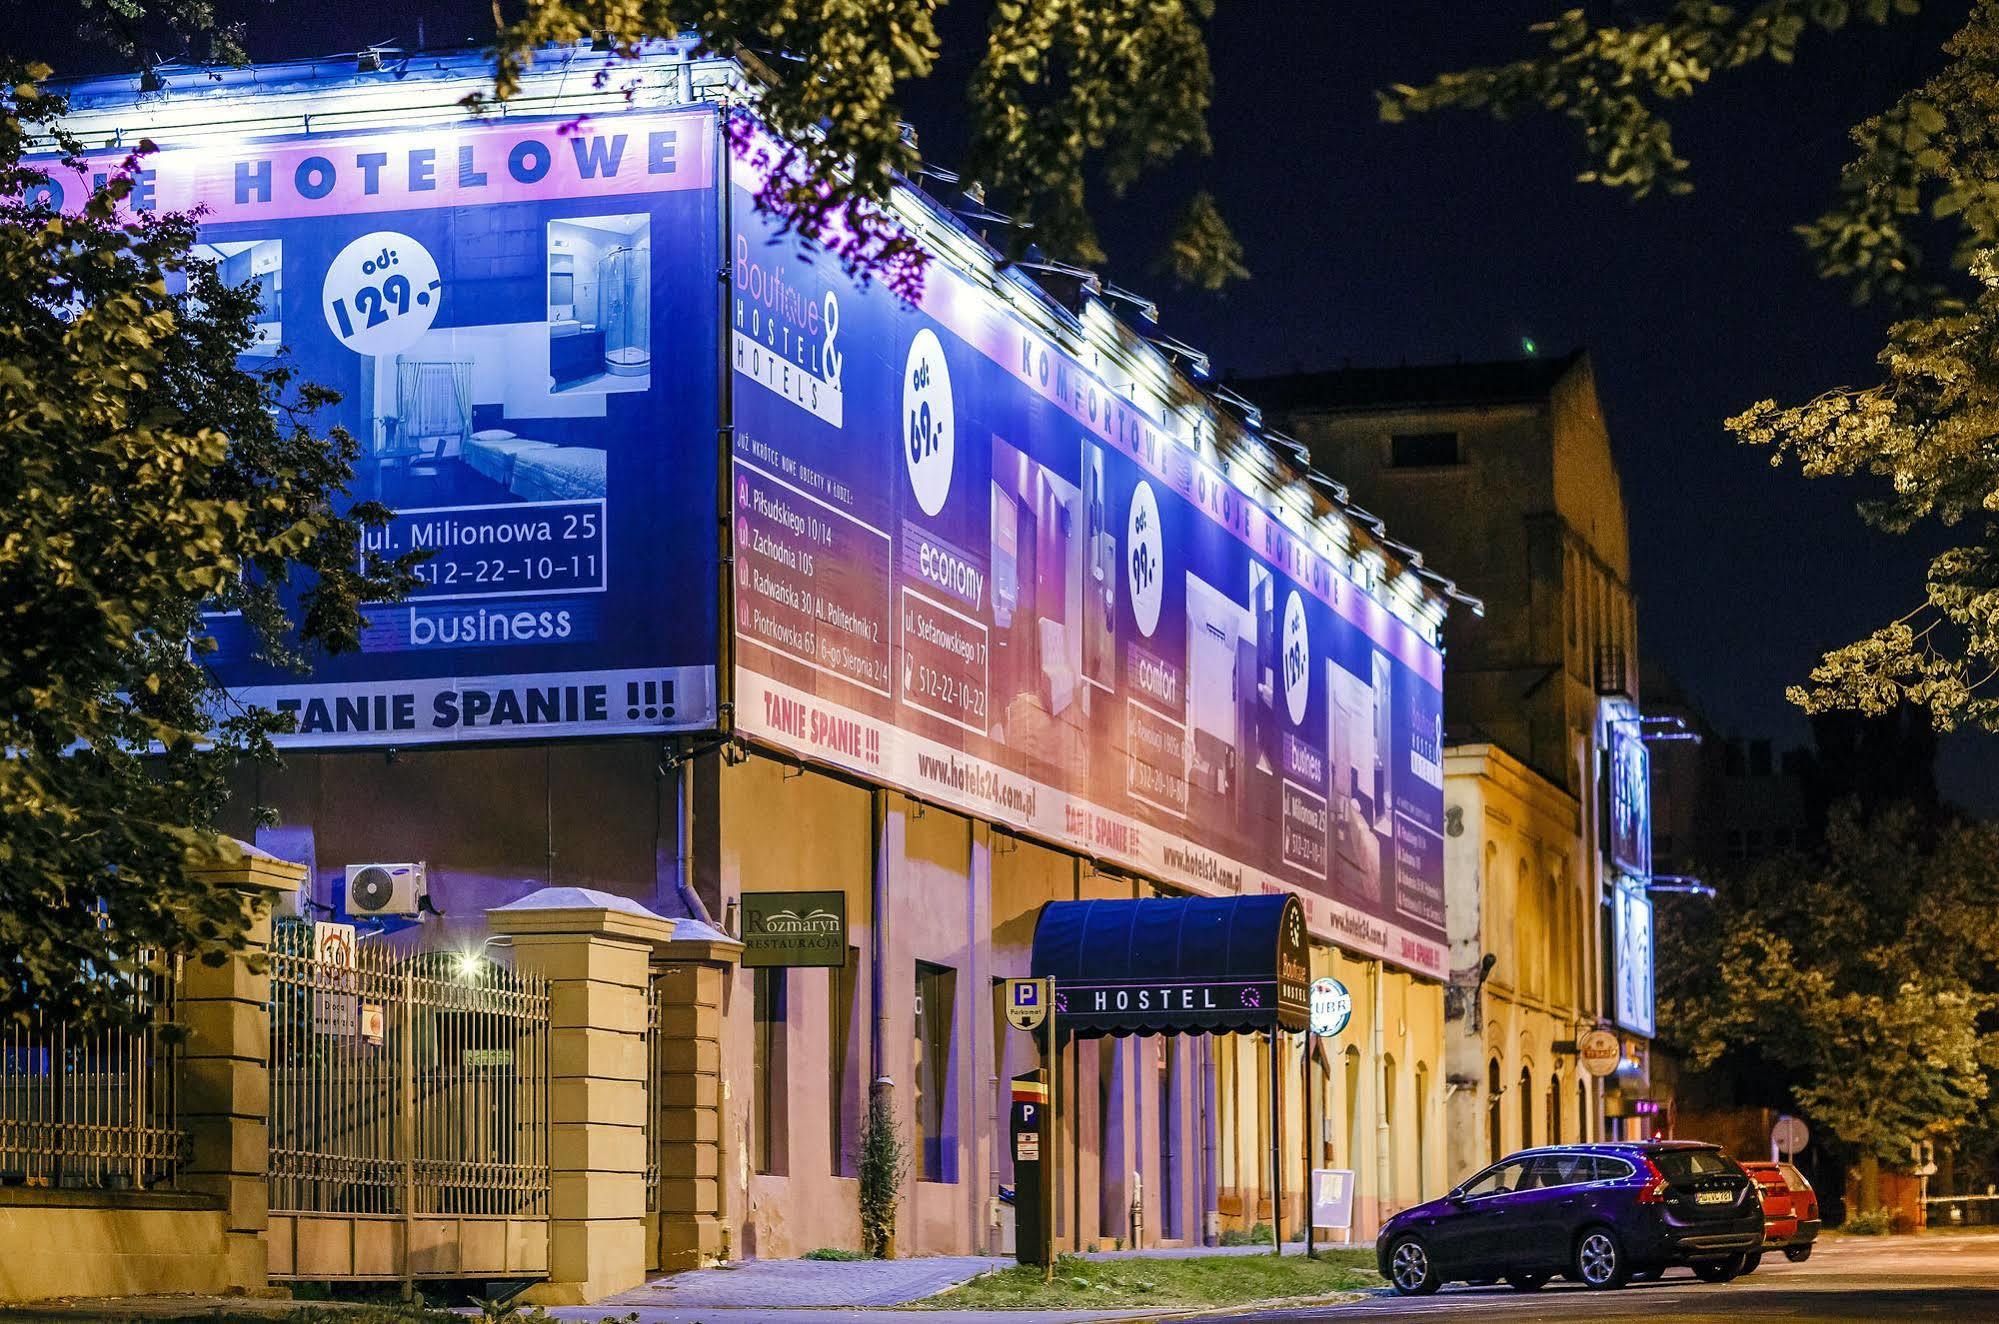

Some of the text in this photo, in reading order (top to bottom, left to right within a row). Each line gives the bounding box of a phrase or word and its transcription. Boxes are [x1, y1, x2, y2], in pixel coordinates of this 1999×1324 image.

[234, 131, 678, 205] HOTELOWE
[361, 247, 400, 275] od:
[737, 299, 819, 373] HOSTEL
[822, 290, 843, 392] &
[737, 339, 818, 410] HOTEL'S
[913, 357, 930, 392] od:
[737, 432, 750, 451] JUŻ
[752, 440, 779, 467] WKRÓTCE
[782, 453, 797, 477] NOWE
[800, 463, 825, 490] OBIEKTY
[367, 514, 597, 550] ul. Milionowa 25
[739, 487, 833, 548] Al. Piłsudskiego 10/14
[1186, 462, 1250, 537] OKOJE
[1265, 523, 1339, 605] HOTELOWE
[413, 554, 597, 585] 512-22-10-11
[739, 525, 814, 577] ul. Zachodnia 105
[919, 542, 984, 611] economy
[410, 607, 572, 646] business
[740, 565, 751, 588] ul.
[753, 569, 799, 610] Radwańska
[828, 603, 872, 640] Politechniki
[872, 622, 878, 643] 2
[740, 605, 752, 630] ul.
[753, 609, 803, 648] Piotrkowska
[843, 648, 873, 678] Sierpnia
[905, 611, 985, 665] ul. Stefanowskiego 17
[432, 684, 608, 728] SPANIE
[626, 680, 676, 720] !!!
[919, 666, 985, 716] 512-22-10-22
[1139, 660, 1176, 703] comfort
[764, 690, 880, 765] TANIE SPANIE !!!
[1291, 734, 1322, 783] business
[918, 753, 1036, 824] www.hotels24.com.pl
[1095, 816, 1128, 852] SPANIE
[1162, 845, 1243, 895] www.hotels24.com.pl
[746, 938, 839, 951] RESTAURACJA
[747, 910, 840, 937] Rozmaryn
[1019, 984, 1034, 1004] P
[1094, 988, 1216, 1011] HOSTEL
[1310, 999, 1347, 1014] UBR
[1023, 1104, 1035, 1122] P
